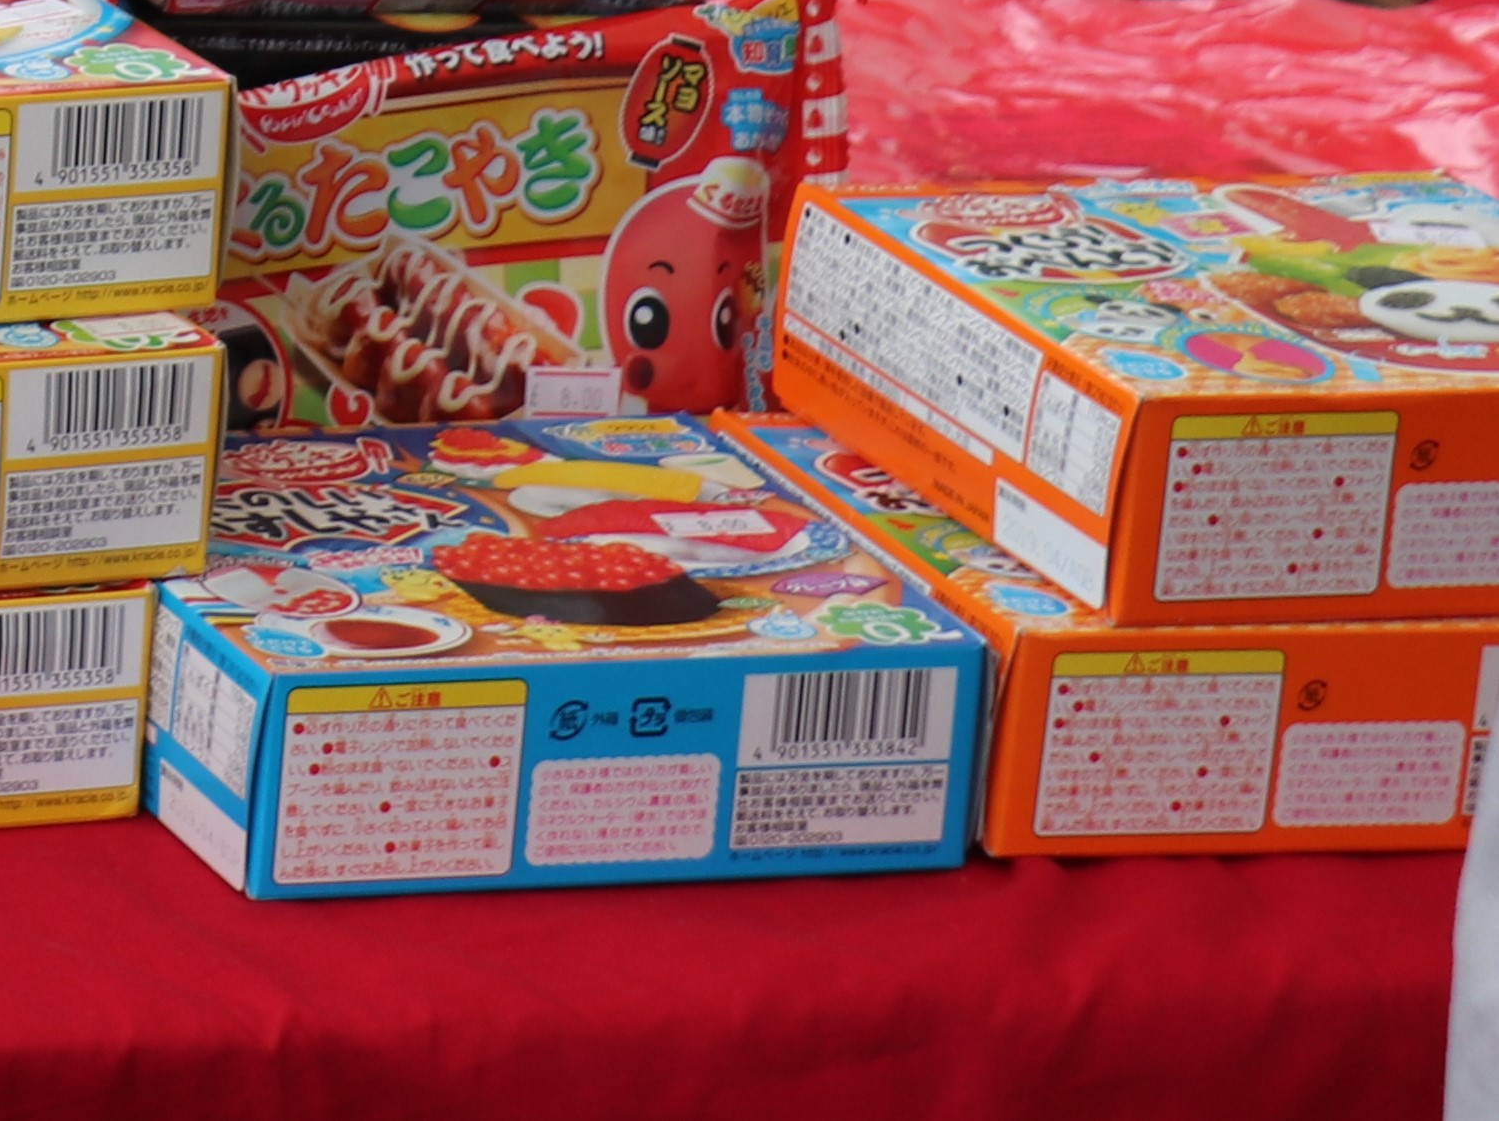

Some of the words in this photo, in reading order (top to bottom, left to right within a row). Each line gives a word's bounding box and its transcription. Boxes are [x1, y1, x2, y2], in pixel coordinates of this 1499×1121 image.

[402, 32, 604, 79] 作って食べよう!
[58, 168, 119, 184] 901551
[129, 160, 192, 180] 355358
[50, 432, 112, 451] 901551
[121, 426, 182, 446] 355358
